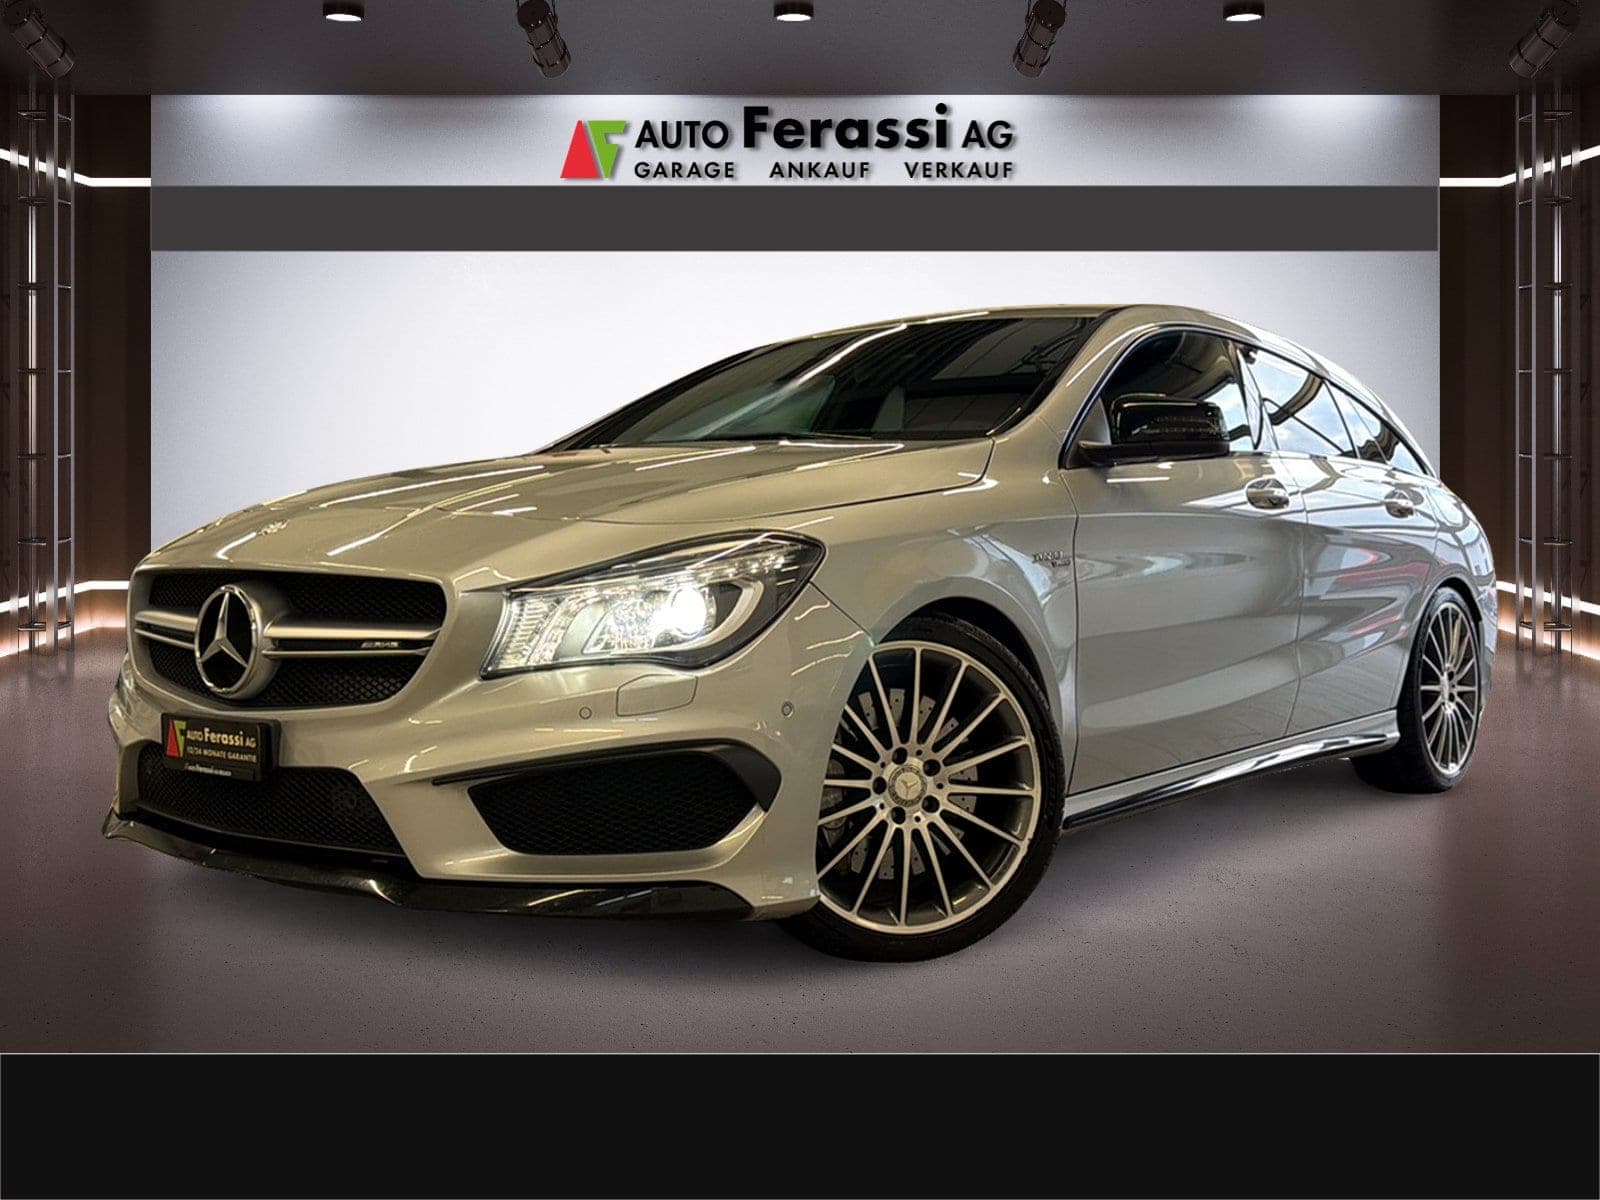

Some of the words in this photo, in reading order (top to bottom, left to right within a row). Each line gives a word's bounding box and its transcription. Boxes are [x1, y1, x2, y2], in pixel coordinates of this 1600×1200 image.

[634, 119, 730, 149] AUTO
[742, 102, 949, 149] Ferassi
[961, 119, 1014, 149] AG
[633, 161, 735, 179] GARAGE
[768, 161, 871, 179] ANKAUF
[904, 161, 1014, 179] VERKAUF
[203, 727, 244, 746] Ferassi
[245, 737, 257, 748] AG
